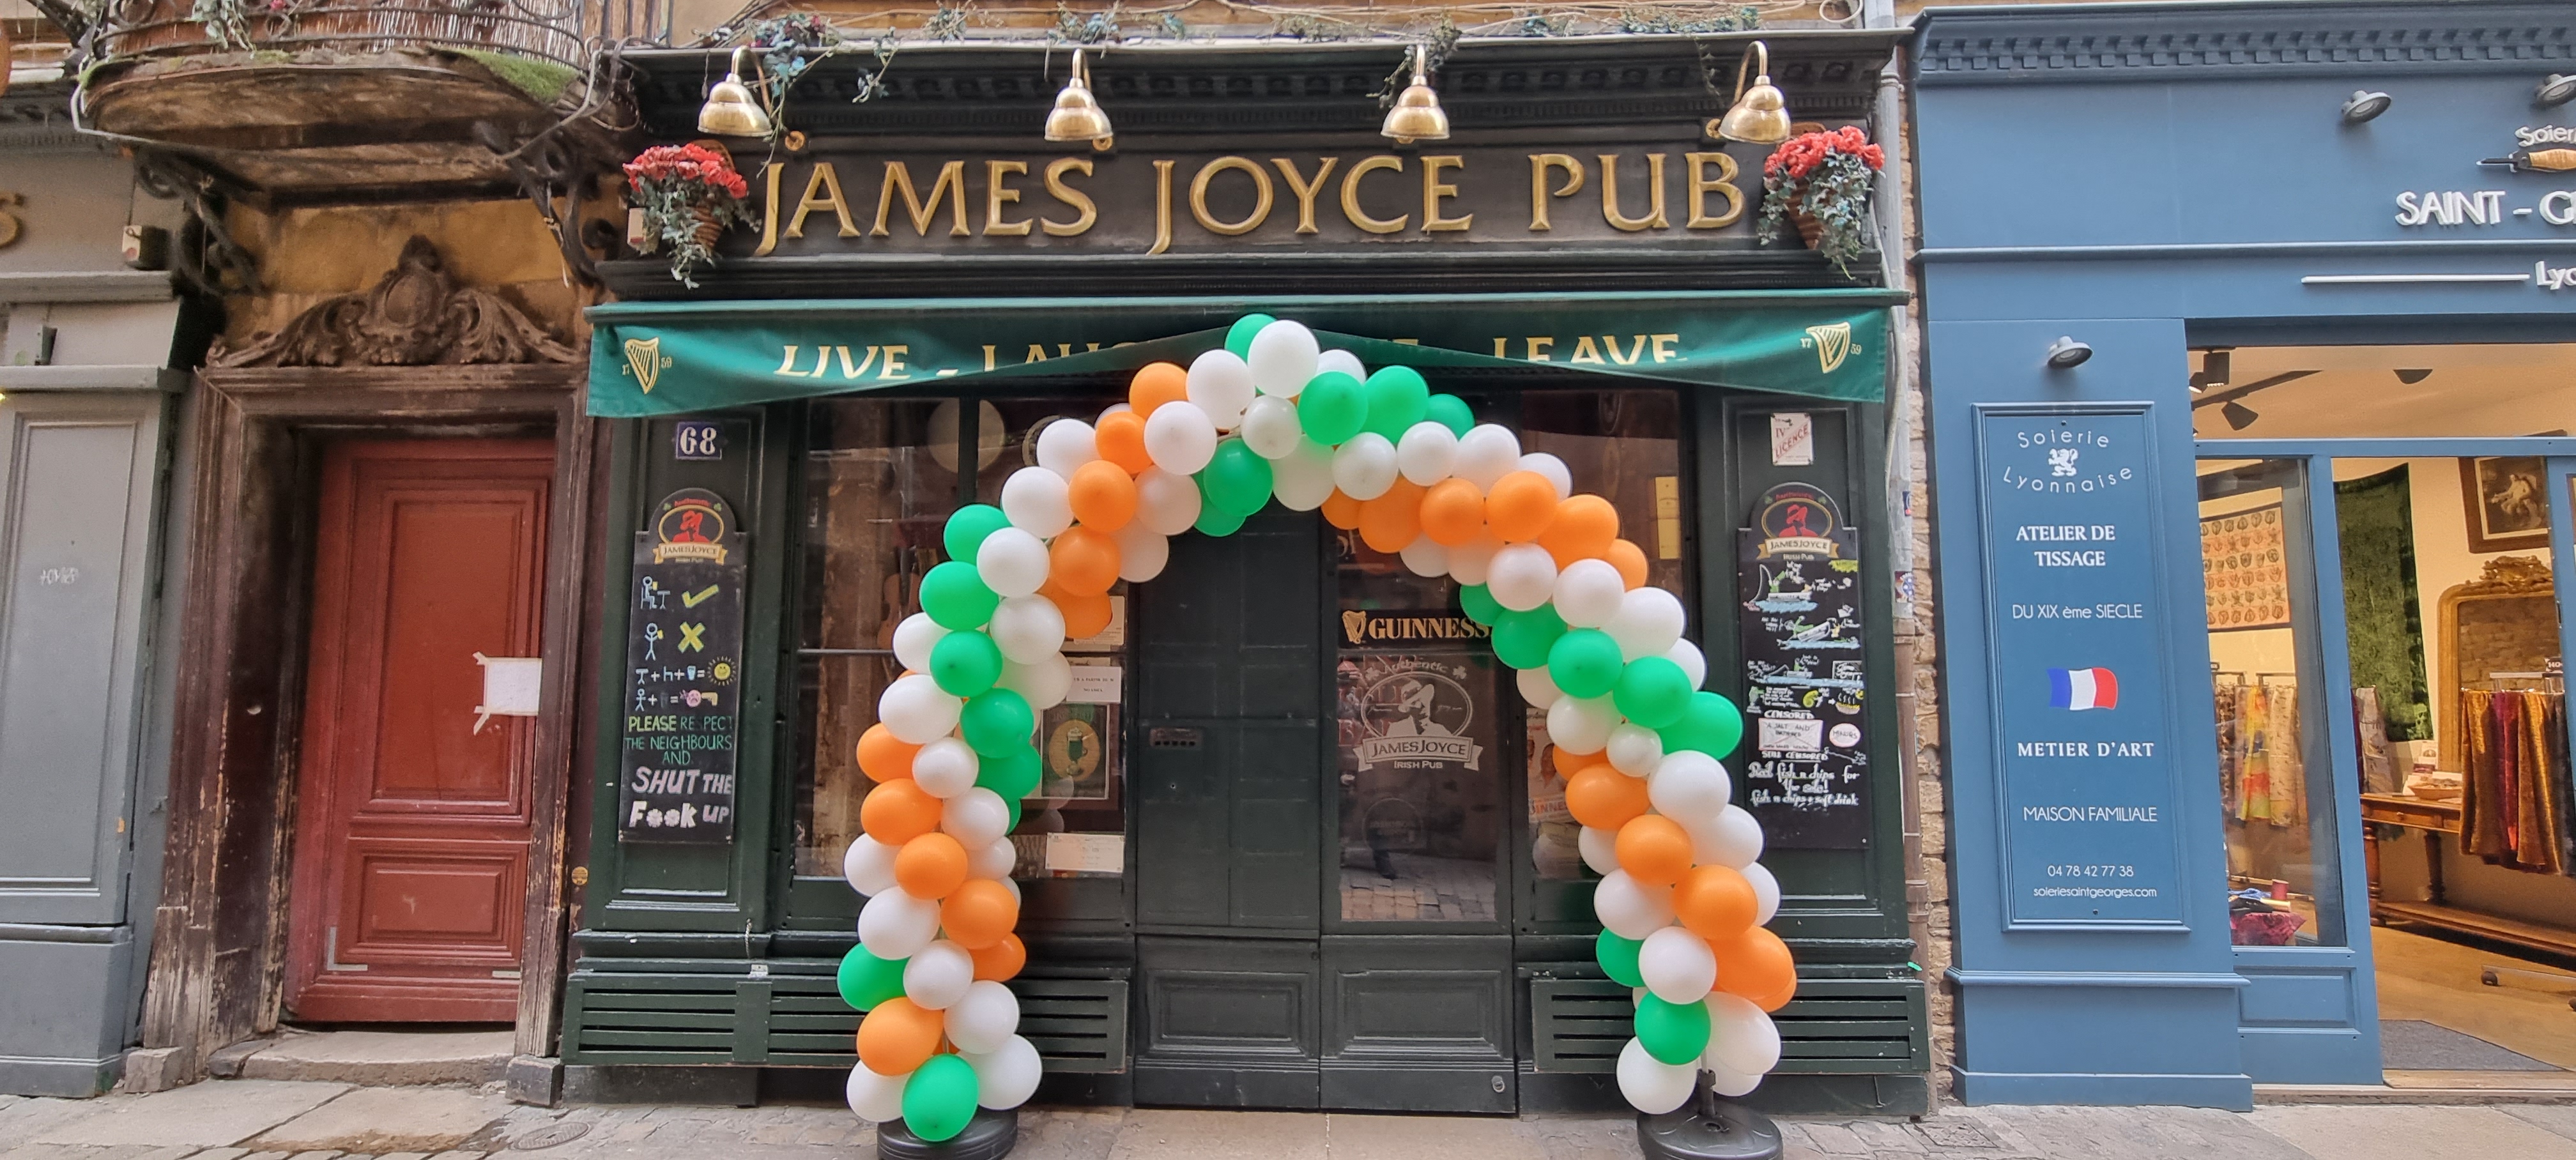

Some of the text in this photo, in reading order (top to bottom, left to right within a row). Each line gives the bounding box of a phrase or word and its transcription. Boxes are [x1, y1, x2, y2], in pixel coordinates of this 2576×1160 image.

[2515, 125, 2576, 147] Soier
[754, 152, 1746, 256] JAMES JOYCE PUB
[2395, 190, 2506, 226] SAINT
[2539, 190, 2576, 225] G
[773, 344, 911, 380] LIVE
[680, 426, 718, 455] 68
[1775, 423, 1808, 459] LICENCE
[2018, 429, 2109, 448] Soierie
[2003, 466, 2132, 494] Lyonnaise
[2016, 525, 2116, 541] ATELIER DE
[2034, 551, 2106, 567] TISSAGE
[2012, 604, 2143, 619] DU XIX ème SIECLE
[1368, 617, 1492, 640] GUINNESS
[1763, 710, 1815, 720] CENSORED
[628, 715, 677, 733] PLEASE
[624, 735, 733, 751] THE NEIGHBOURS
[2017, 742, 2155, 757] METIER D'ART
[662, 750, 691, 765] AND
[1785, 751, 1829, 761] CENSORED
[631, 767, 733, 795] SHUT THE
[2023, 806, 2159, 822] MAISON FAMILIALE
[2047, 865, 2135, 877] 04 78 42 77 38
[2033, 886, 2158, 899] soieriesaintgeorges.com
